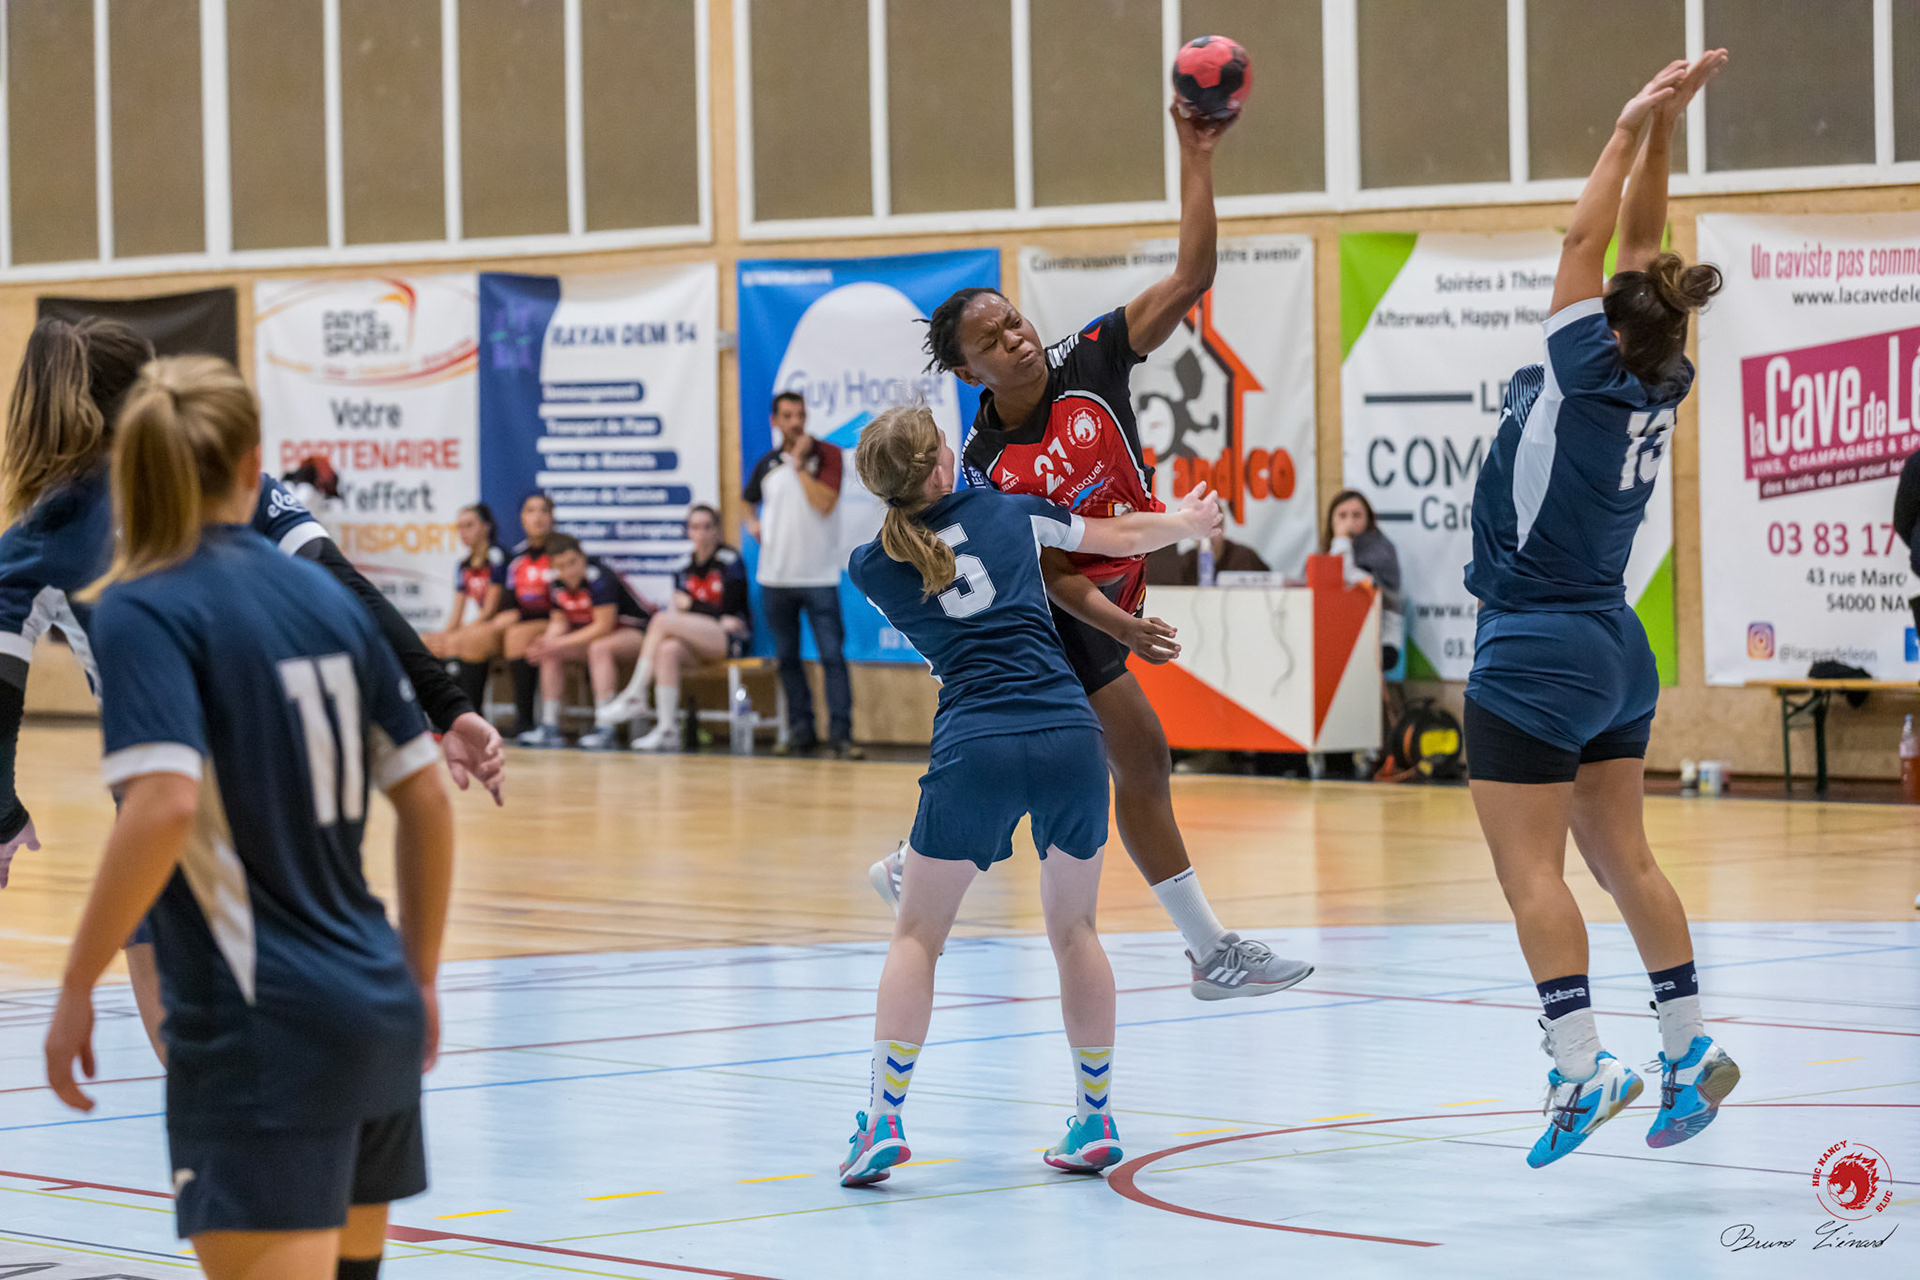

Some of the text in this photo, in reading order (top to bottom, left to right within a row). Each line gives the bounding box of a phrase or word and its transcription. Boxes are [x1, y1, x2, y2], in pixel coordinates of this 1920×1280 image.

[1752, 244, 1771, 279] Un
[1776, 242, 1831, 279] caviste
[1836, 250, 1864, 282] pas
[1436, 273, 1491, 292] Soirées
[1511, 271, 1556, 289] Thèm
[676, 322, 697, 343] 54
[1377, 306, 1552, 329] Afterwork, Happy Hou
[844, 371, 943, 408] Hoqet
[1766, 356, 1861, 454] Cave
[1863, 391, 1887, 439] de
[331, 401, 402, 428] Votre
[1033, 437, 1075, 496] 27
[1368, 436, 1484, 487] COM
[1618, 408, 1676, 491] 13
[1788, 439, 1884, 471] CHAMPAGNES
[1066, 460, 1105, 498] Hoquet
[339, 522, 461, 554] TISPORT
[1767, 521, 1894, 556] 03 83 17
[937, 522, 997, 619] 5
[1806, 568, 1825, 587] 43
[1829, 571, 1856, 586] rue
[1826, 592, 1913, 612] 54000 NA
[277, 652, 365, 827] 11
